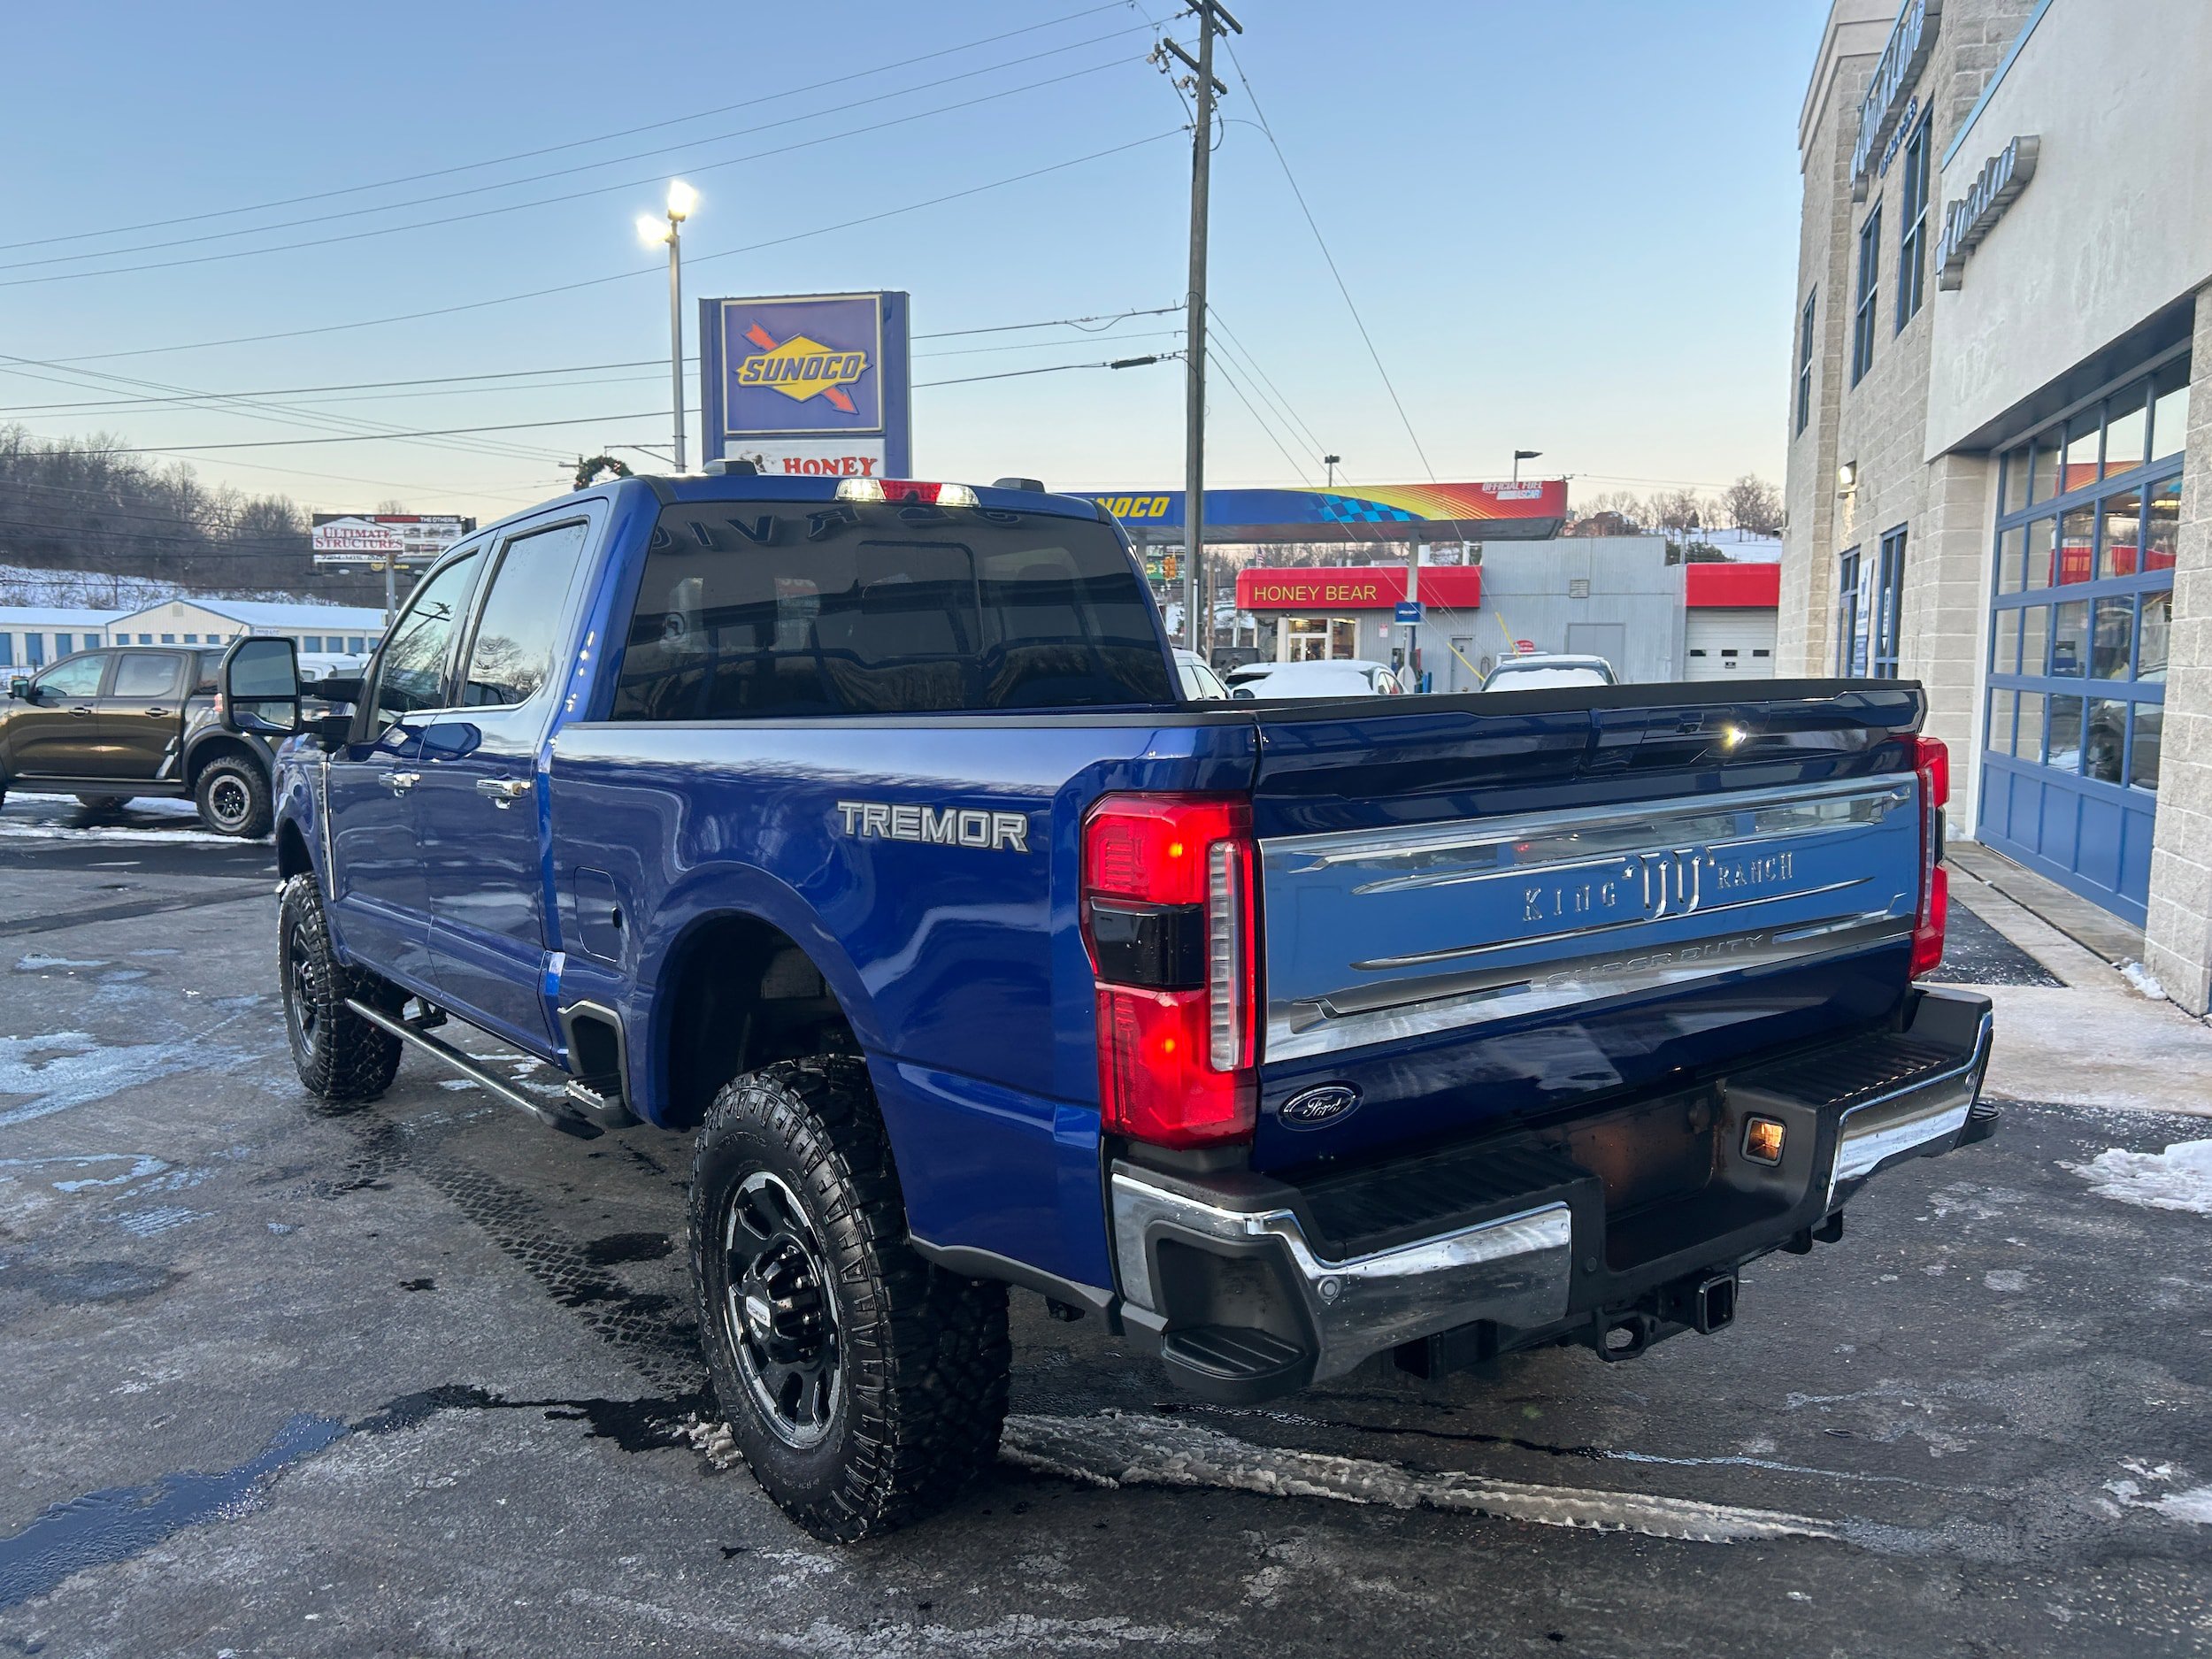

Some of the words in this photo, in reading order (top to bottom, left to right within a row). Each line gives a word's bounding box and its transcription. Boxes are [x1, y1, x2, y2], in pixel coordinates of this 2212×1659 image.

[743, 355, 862, 381] SUNOCO
[783, 457, 878, 476] HONEY
[1482, 482, 1520, 491] OFFICIAL
[315, 538, 403, 549] STRUCTURES
[323, 527, 391, 539] ULTIMATE
[1254, 586, 1320, 602] HONEY
[1325, 586, 1377, 601] BEAR
[837, 801, 1029, 852] TREMOR
[1523, 881, 1616, 922] KING
[1717, 851, 1793, 890] RANCH
[1546, 952, 1672, 987] SUPER
[1680, 934, 1763, 963] DUTY
[1302, 1094, 1342, 1118] Ford
